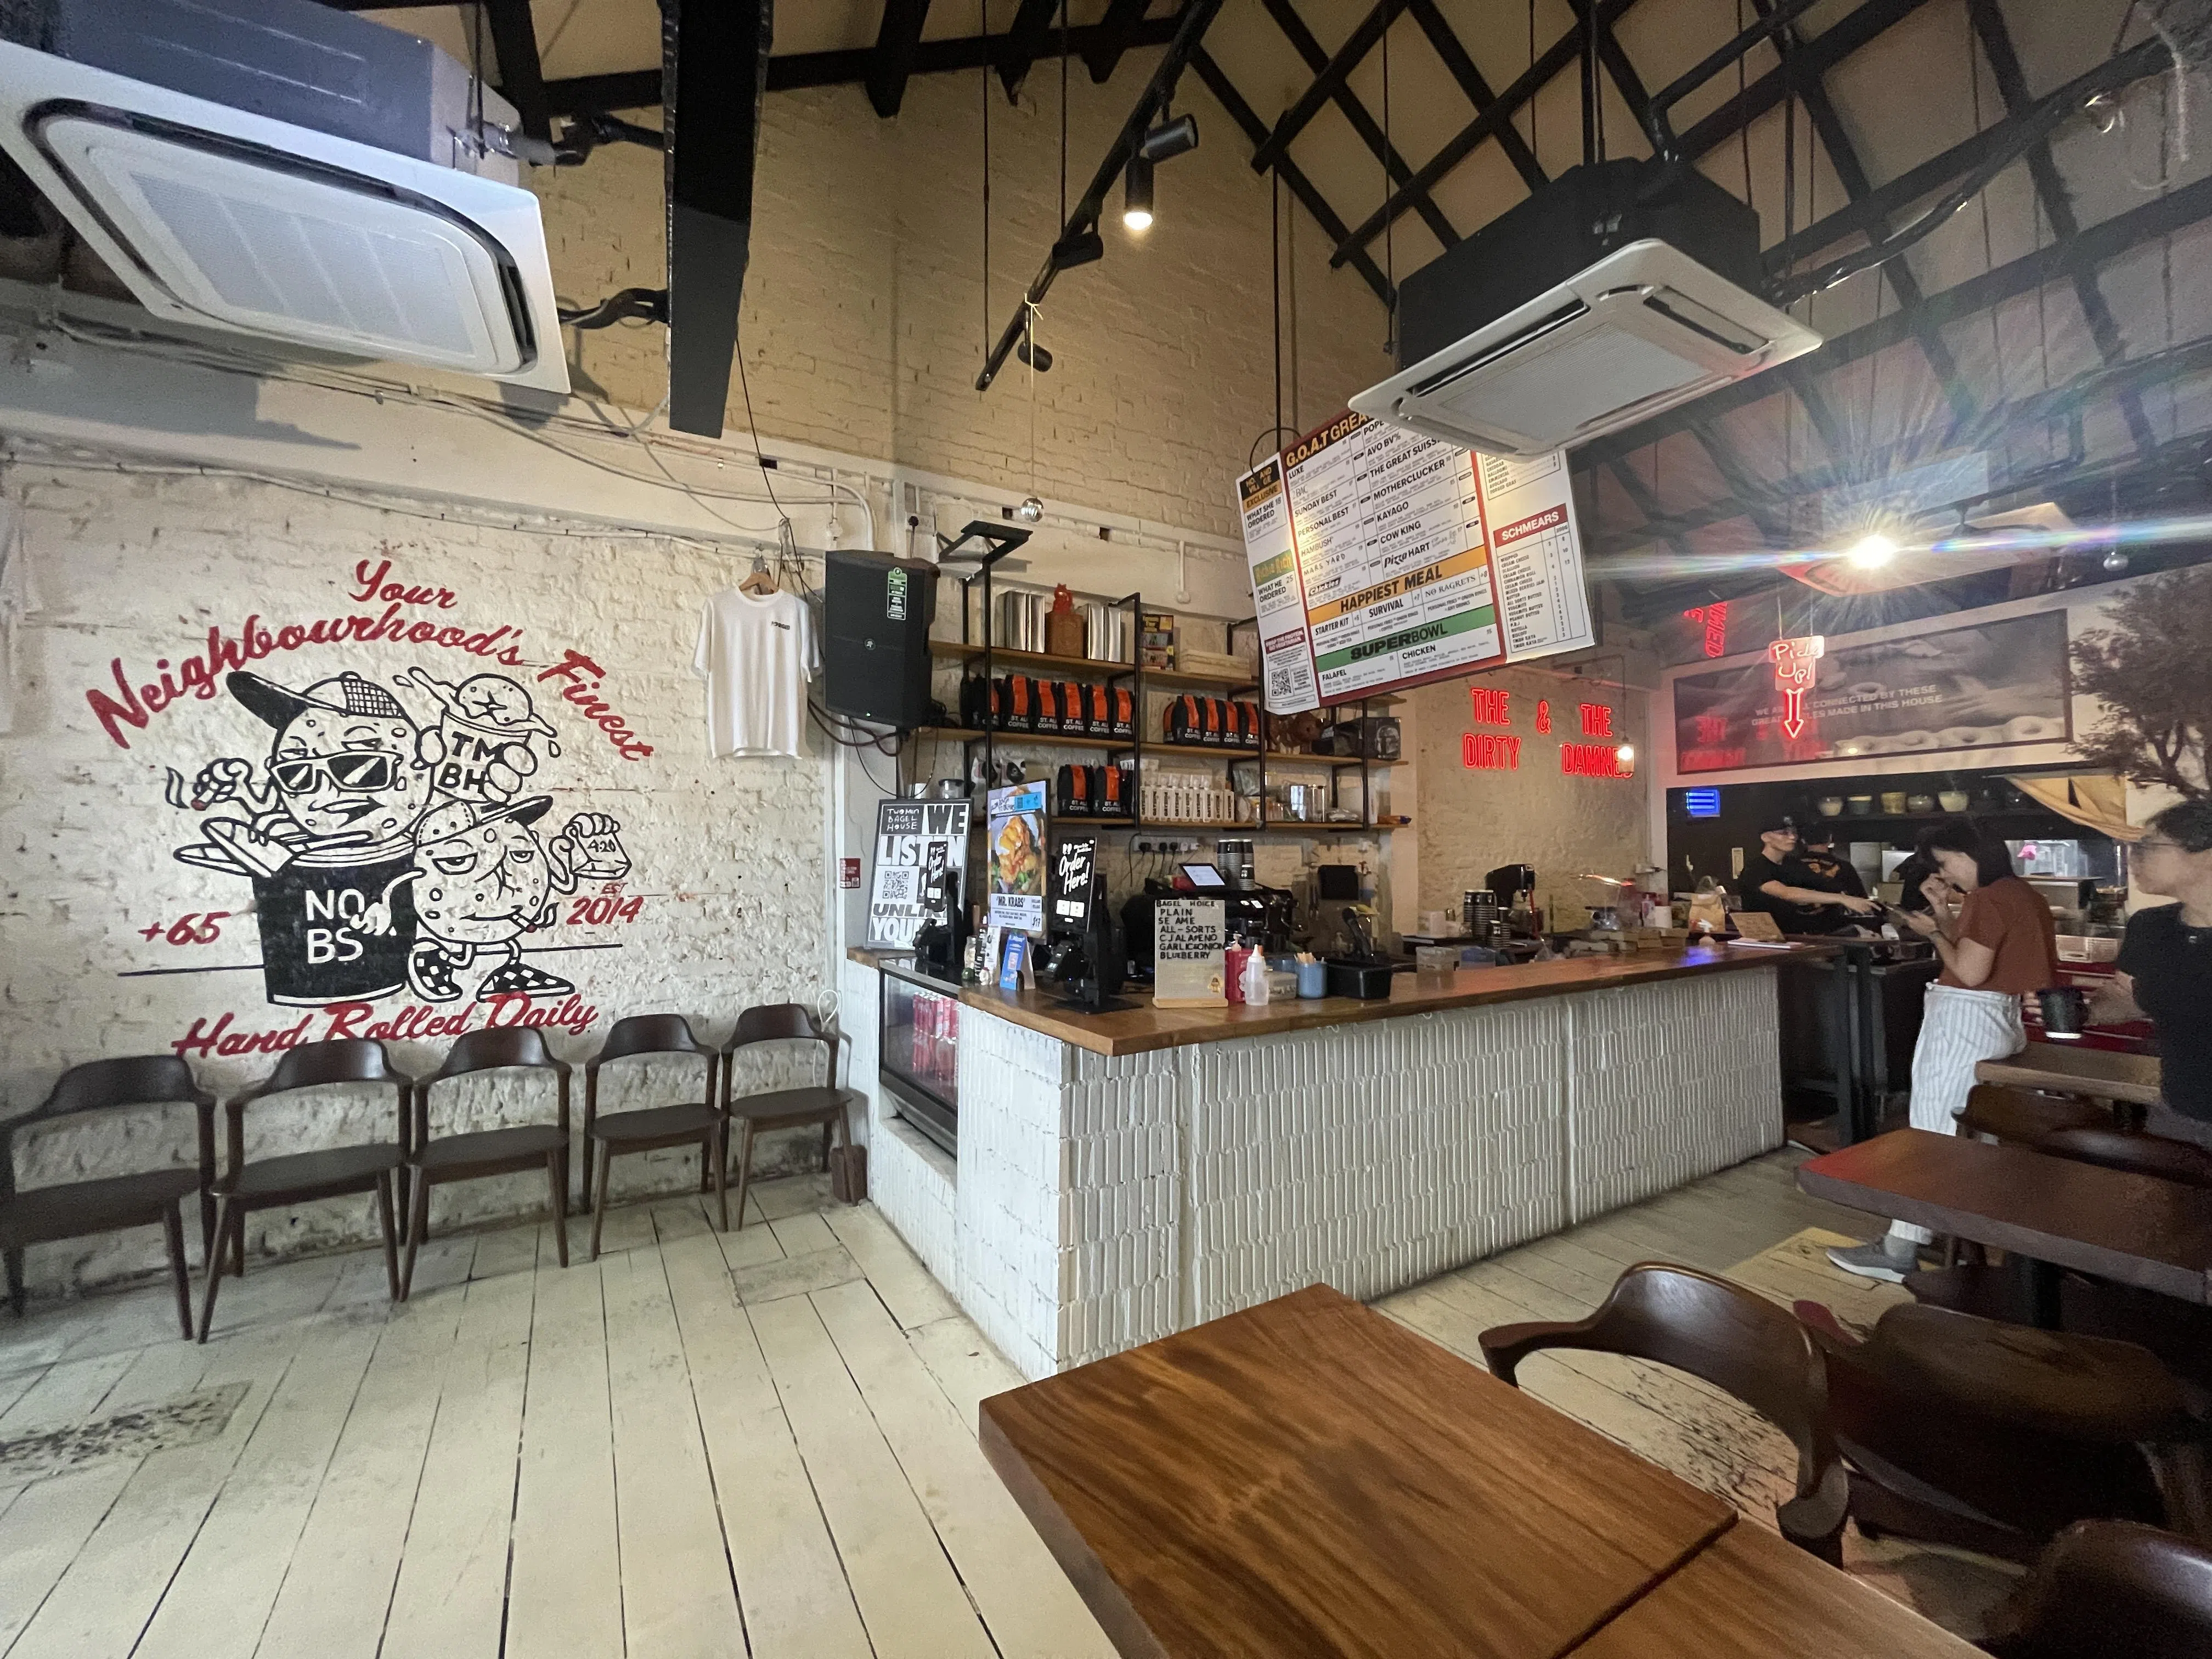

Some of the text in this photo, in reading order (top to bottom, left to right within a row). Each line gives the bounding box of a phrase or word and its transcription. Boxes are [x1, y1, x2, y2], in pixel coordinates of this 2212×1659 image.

[1330, 413, 1370, 440] GREA
[1367, 442, 1382, 456] AVO
[1370, 438, 1440, 478] THE GREAT SUISS
[1289, 465, 1304, 479] LUXE
[1373, 459, 1445, 500] MOTHERCLUCKER
[1247, 507, 1262, 521] WHAT
[1263, 502, 1274, 512] SHE
[1295, 499, 1320, 517] SUNDAY
[1322, 489, 1337, 504] BEST
[1377, 501, 1408, 522] KAYAGO
[1248, 509, 1274, 528] ORDERED
[1298, 516, 1331, 538] PERSONAL
[1333, 506, 1349, 521] BEST
[1502, 511, 1559, 540] SCHMEARS
[1380, 531, 1399, 544] COW
[1401, 521, 1421, 535] KING
[1408, 542, 1430, 557] HART
[1304, 564, 1323, 575] MARS
[1325, 553, 1345, 565] YARD
[348, 559, 458, 608] Your
[1260, 586, 1286, 602] ORDERED
[1341, 580, 1399, 613] HAPPIEST
[1404, 566, 1442, 590] MEAL
[1439, 575, 1476, 593] RAGRETS
[1369, 599, 1403, 617] SURVIVAL
[1316, 620, 1339, 635] STARTER
[1340, 617, 1349, 627] KIT
[1351, 623, 1448, 660] SUPERBOWL
[1402, 645, 1436, 659] CHICKEN
[86, 602, 525, 749] Neighbourhood's
[1322, 669, 1347, 681] FALAFEL
[537, 649, 654, 761] Finest
[1813, 694, 1878, 708] CONNECTED
[1881, 692, 1894, 700] BY
[1898, 685, 1937, 696] THESE
[1828, 706, 1858, 716] MADE
[1860, 703, 1871, 712] IN
[1876, 700, 1899, 710] THIS
[1901, 695, 1943, 707] HOUSE
[1471, 688, 1613, 738] THE & THE
[1463, 733, 1522, 770] DIRTY
[439, 763, 488, 794] BH
[887, 822, 918, 832] HOUSE
[927, 805, 967, 834] WE
[588, 840, 616, 853] 4:20
[1059, 853, 1086, 876] Order
[1064, 861, 1090, 895] Here!
[305, 889, 365, 922] NO
[566, 896, 644, 926] 2014
[138, 911, 232, 946] +65
[307, 928, 364, 964] BS
[171, 991, 599, 1058] Hand Rolled Daily
